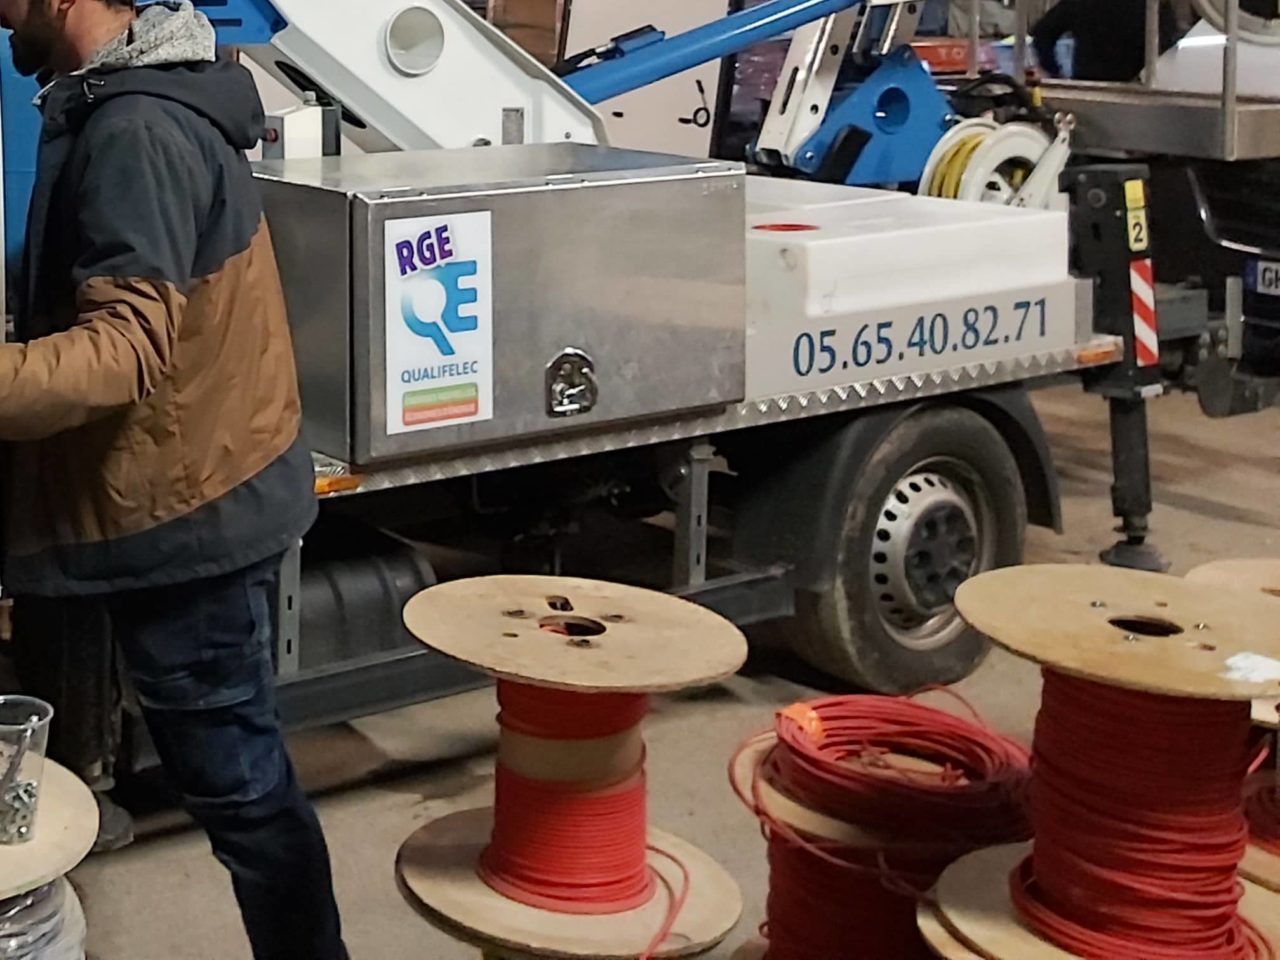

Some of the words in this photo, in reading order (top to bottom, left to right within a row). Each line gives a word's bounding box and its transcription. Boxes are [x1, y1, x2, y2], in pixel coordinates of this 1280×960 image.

[395, 224, 453, 276] RGE
[1132, 221, 1143, 244] 2
[793, 298, 1046, 376] 05.65.40.82.71
[401, 361, 478, 383] QUALIFELEC
